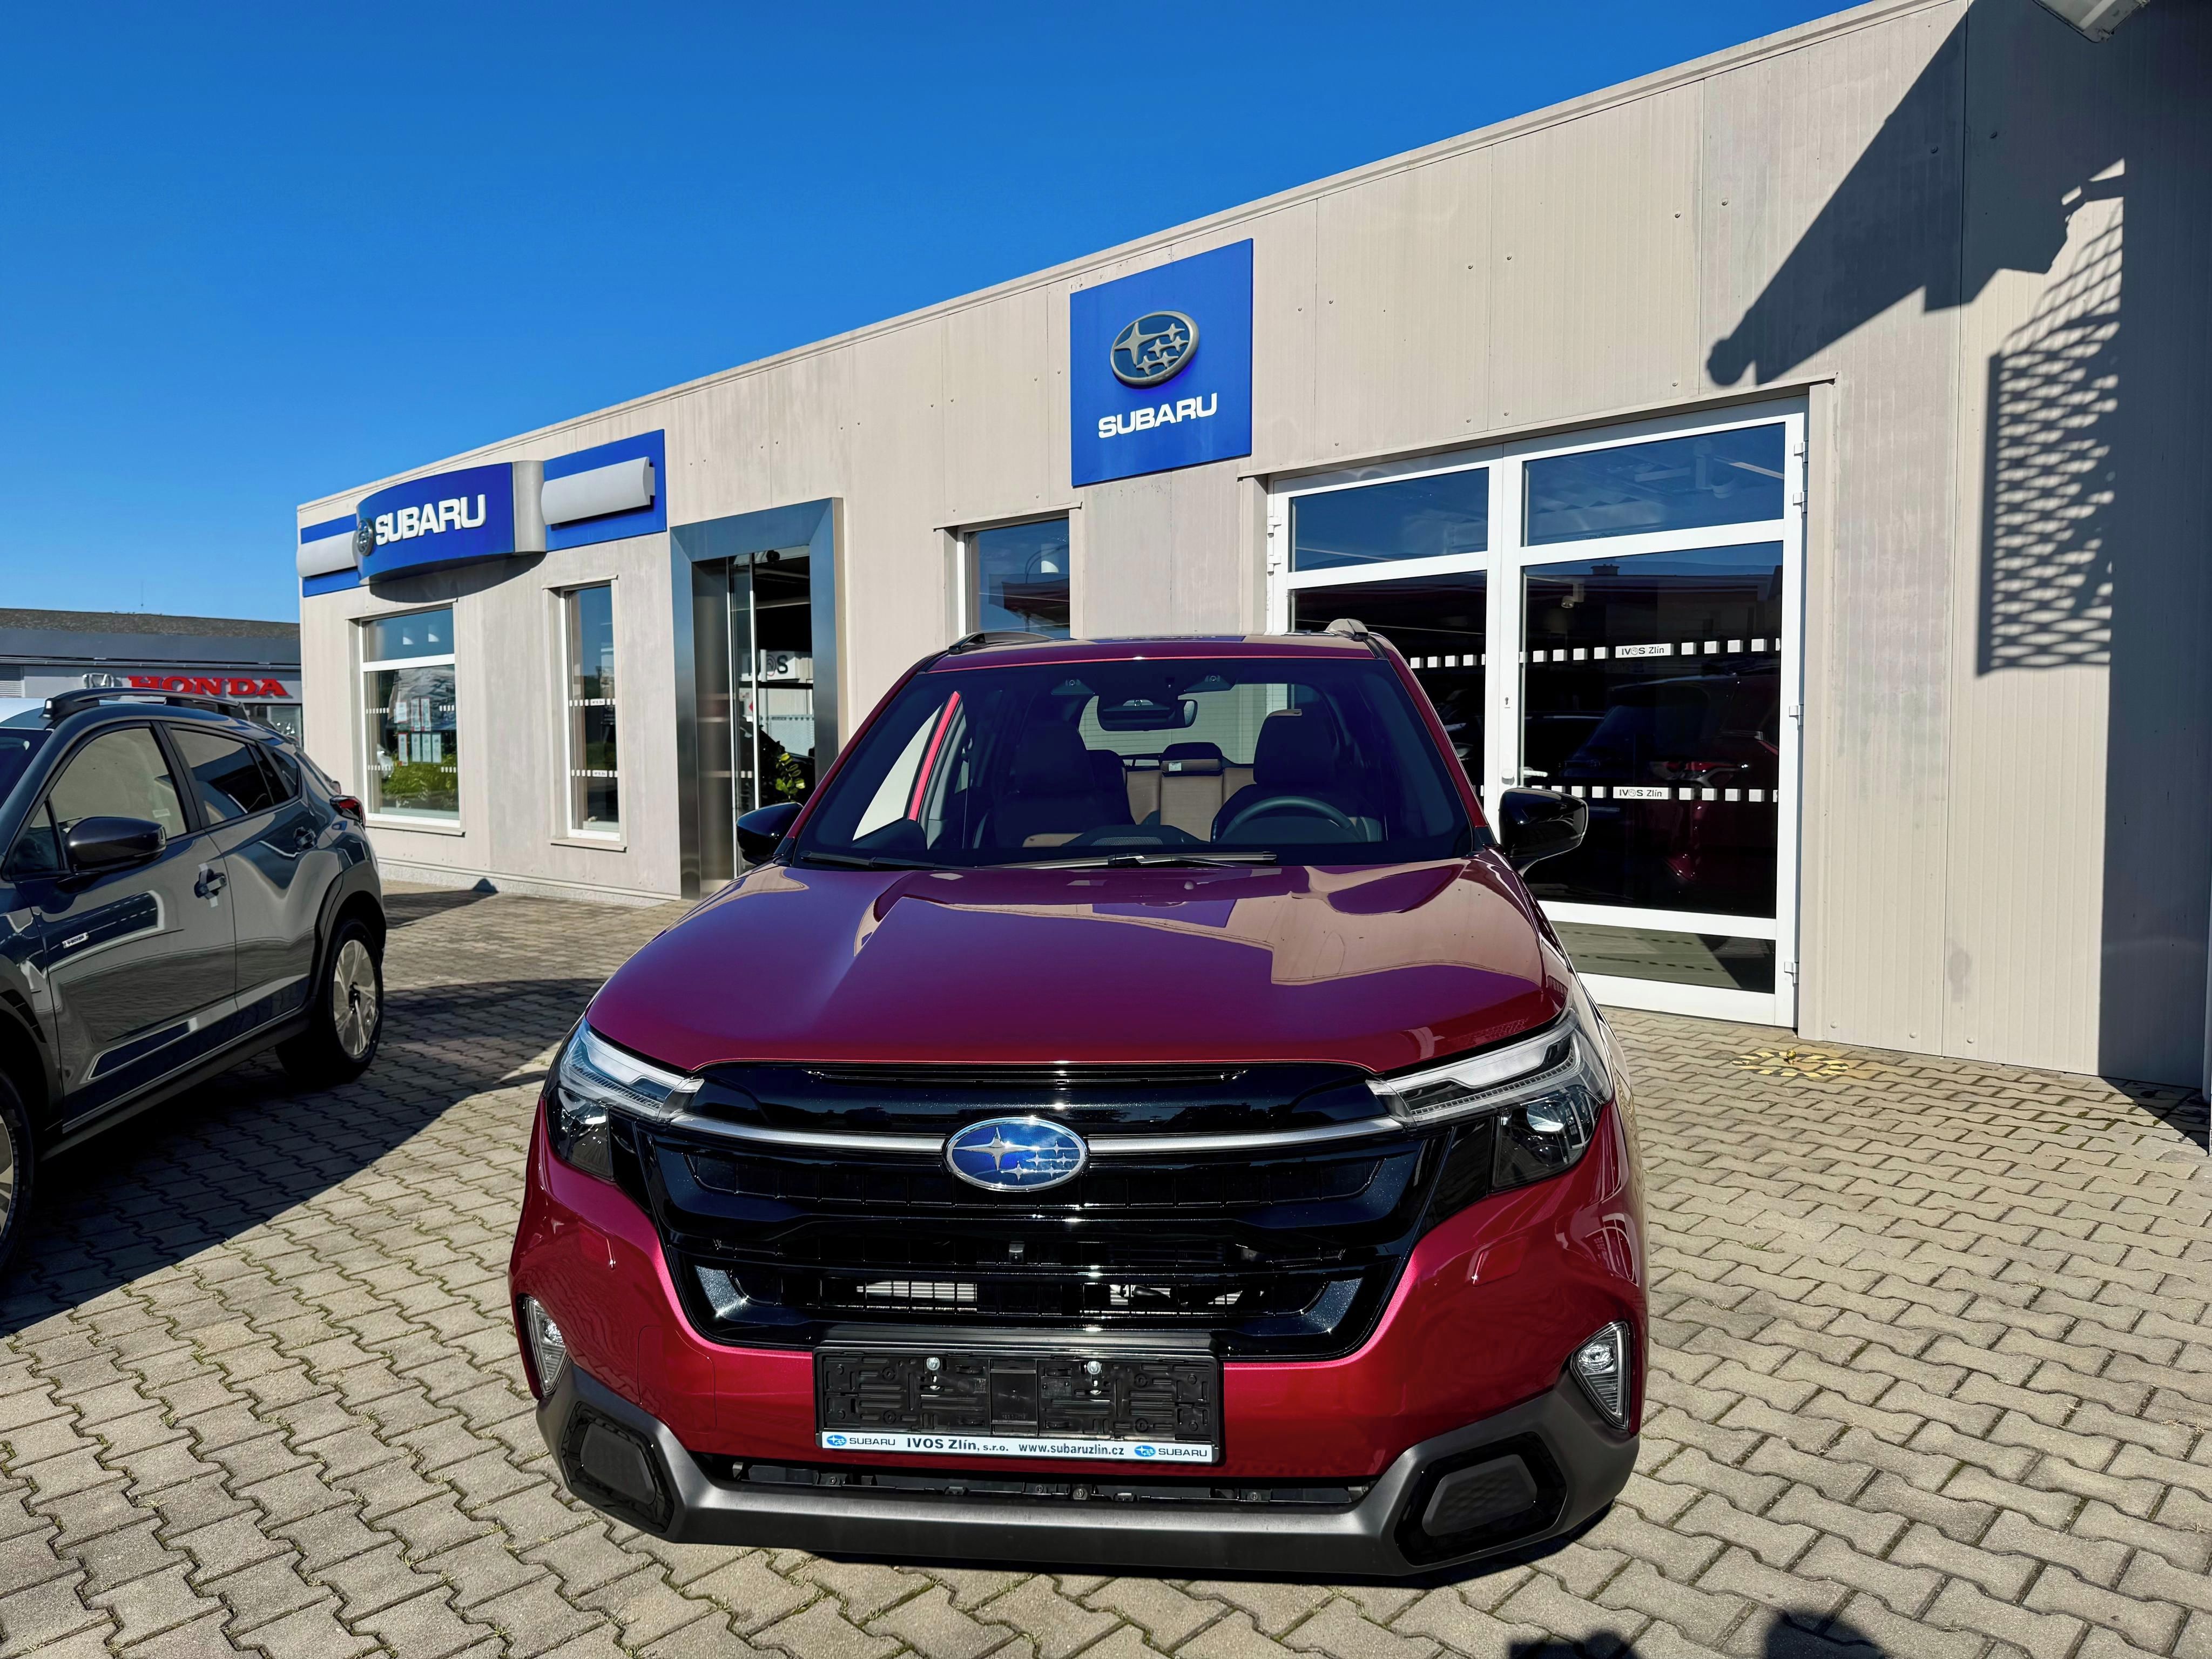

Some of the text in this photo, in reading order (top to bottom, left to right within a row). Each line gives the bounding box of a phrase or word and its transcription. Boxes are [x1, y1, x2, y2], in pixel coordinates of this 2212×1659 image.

[1098, 393, 1217, 439] SUBARU
[375, 494, 486, 545] SUBARU
[127, 676, 289, 696] HONDA
[849, 1437, 896, 1446] SUBARU
[907, 1438, 944, 1448] IVOS
[948, 1439, 980, 1452] Zlín,
[1018, 1443, 1125, 1455] www.subaruzlin.cz
[1158, 1448, 1208, 1457] SUBARU
